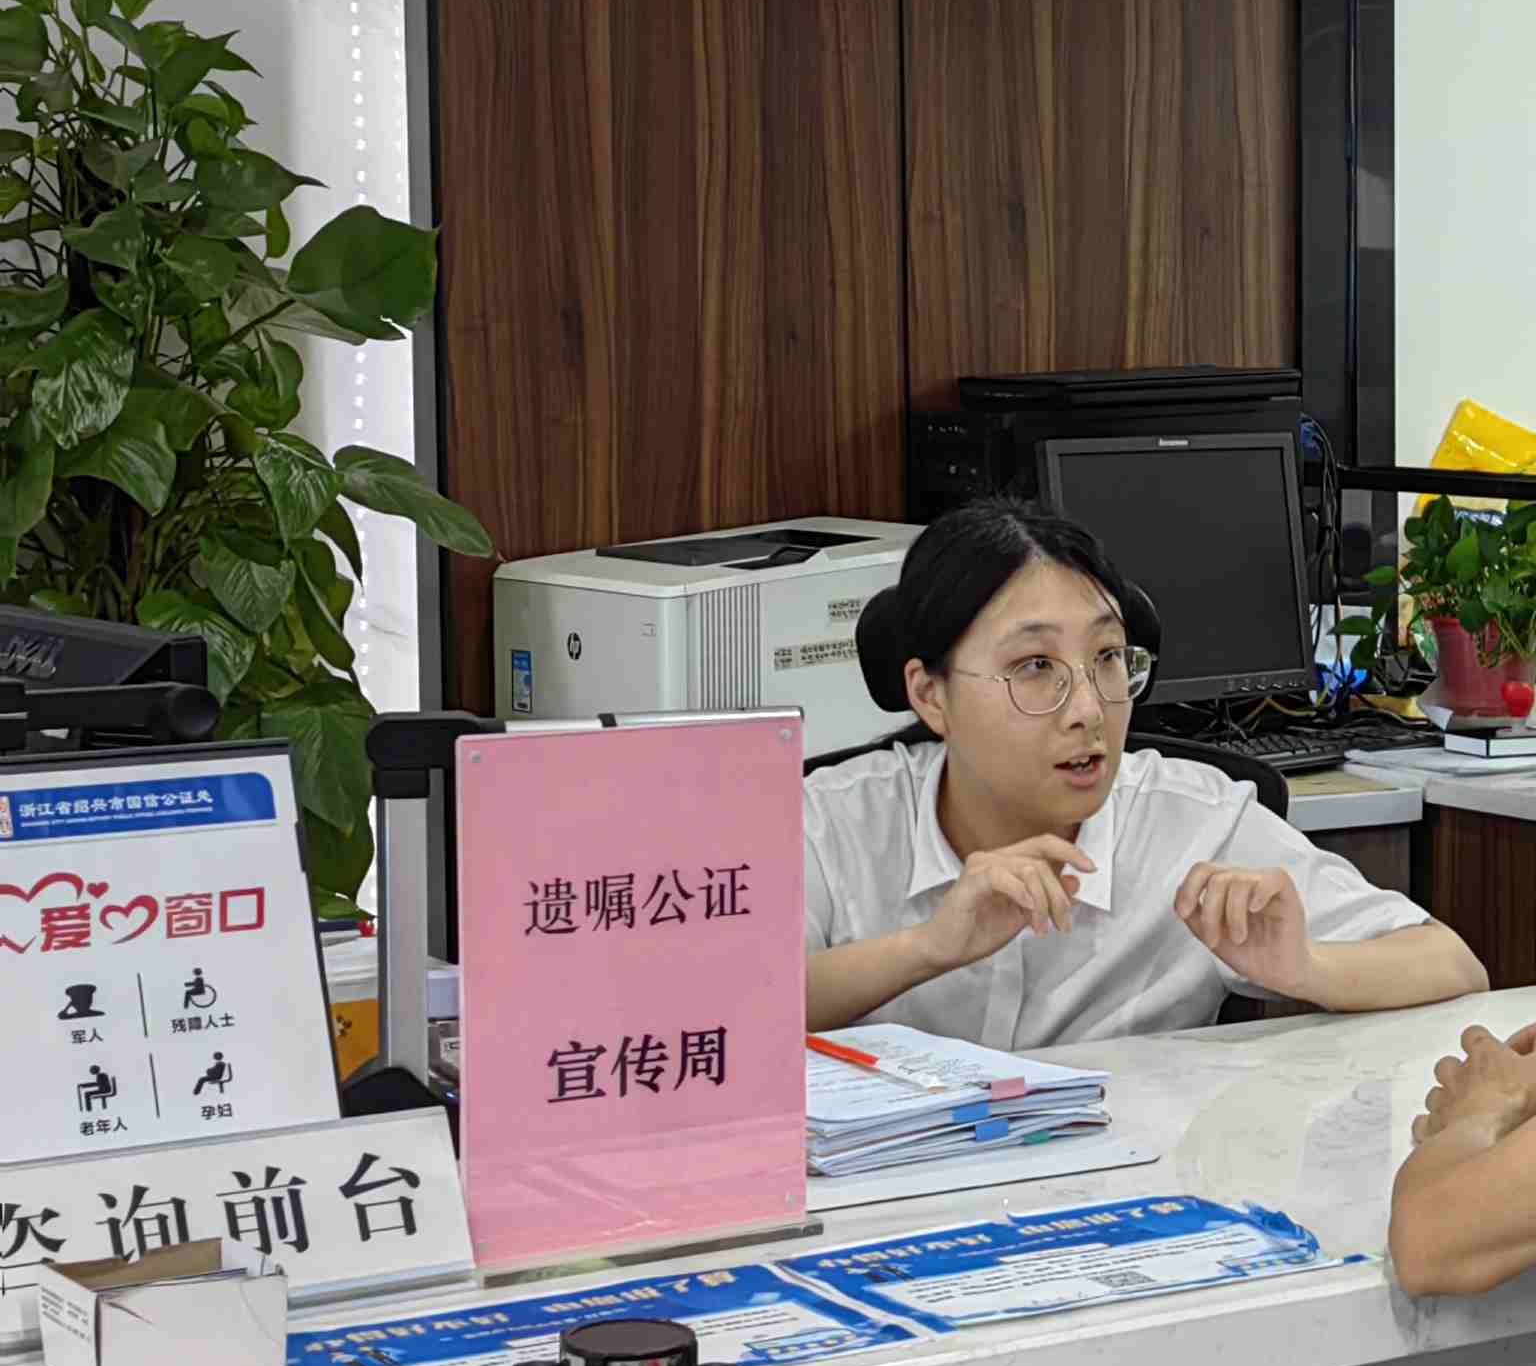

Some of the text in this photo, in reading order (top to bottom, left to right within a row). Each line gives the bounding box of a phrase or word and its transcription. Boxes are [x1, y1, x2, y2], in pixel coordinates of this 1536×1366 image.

[523, 863, 751, 936] 遗嘱公证
[170, 1013, 235, 1033] 残障人士
[71, 1028, 104, 1044] 军人
[547, 1025, 727, 1104] 宣传周
[201, 1103, 233, 1120] 孕妇
[80, 1117, 128, 1136] 老年人
